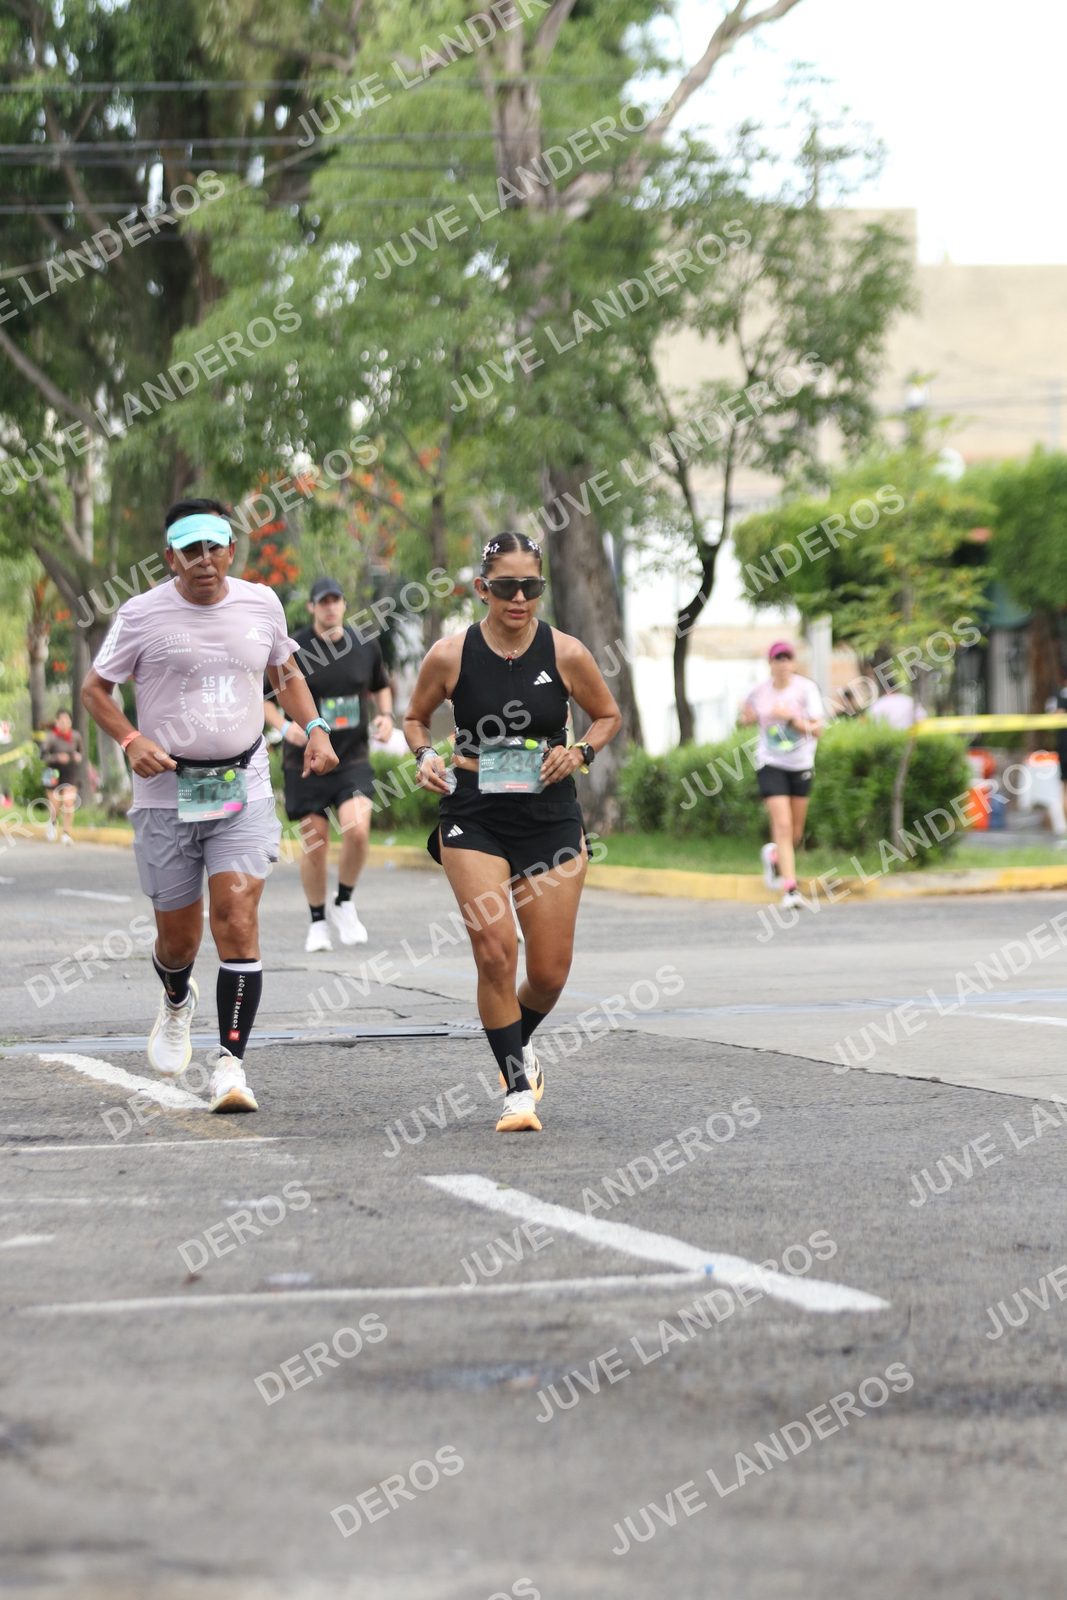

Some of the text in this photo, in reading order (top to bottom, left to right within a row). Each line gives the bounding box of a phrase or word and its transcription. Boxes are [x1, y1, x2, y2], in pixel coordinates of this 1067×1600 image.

[202, 675, 215, 688] 15
[219, 675, 236, 704] K
[202, 692, 215, 704] 30
